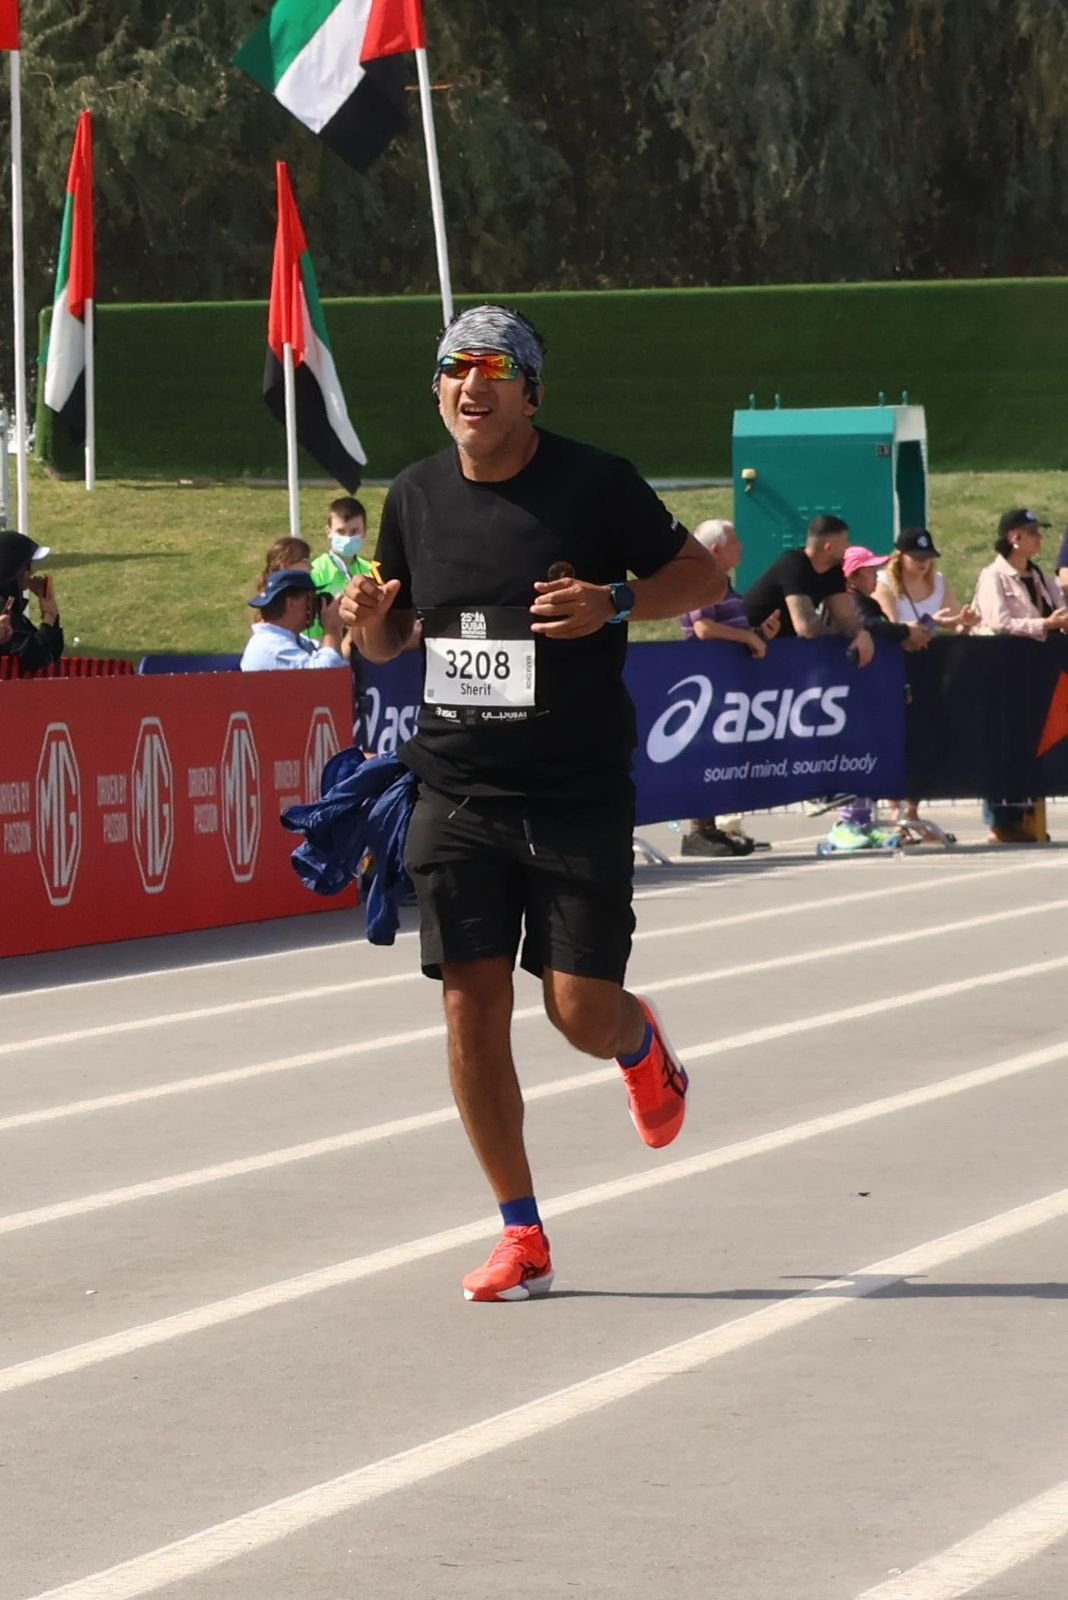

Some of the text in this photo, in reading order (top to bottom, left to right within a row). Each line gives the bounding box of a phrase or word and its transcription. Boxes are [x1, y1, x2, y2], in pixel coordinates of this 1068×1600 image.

[461, 622, 486, 631] DUBAI
[445, 649, 511, 680] 3208
[461, 683, 491, 696] Sherif
[712, 685, 850, 743] asics
[704, 752, 878, 783] sound mind, sound body
[40, 740, 77, 887] MG
[136, 734, 170, 876] MG
[225, 729, 257, 865] MG
